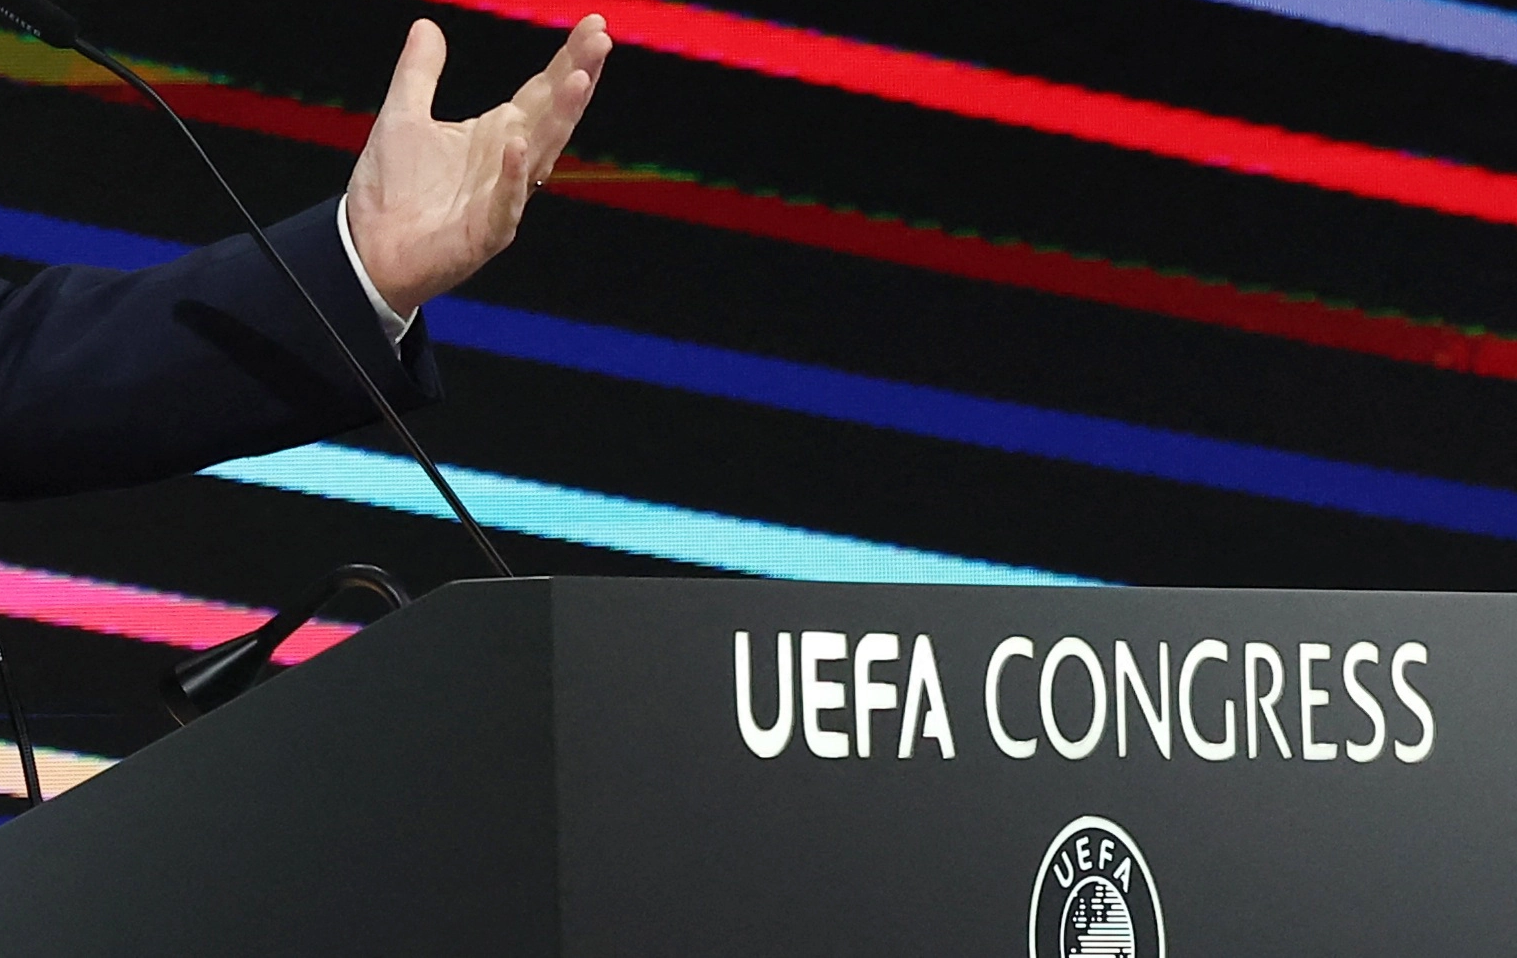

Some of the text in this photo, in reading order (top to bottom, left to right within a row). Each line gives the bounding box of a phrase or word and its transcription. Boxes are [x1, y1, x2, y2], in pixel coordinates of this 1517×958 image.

[734, 630, 1436, 763] UEFA CONGRESS
[1052, 835, 1133, 894] UEFA
